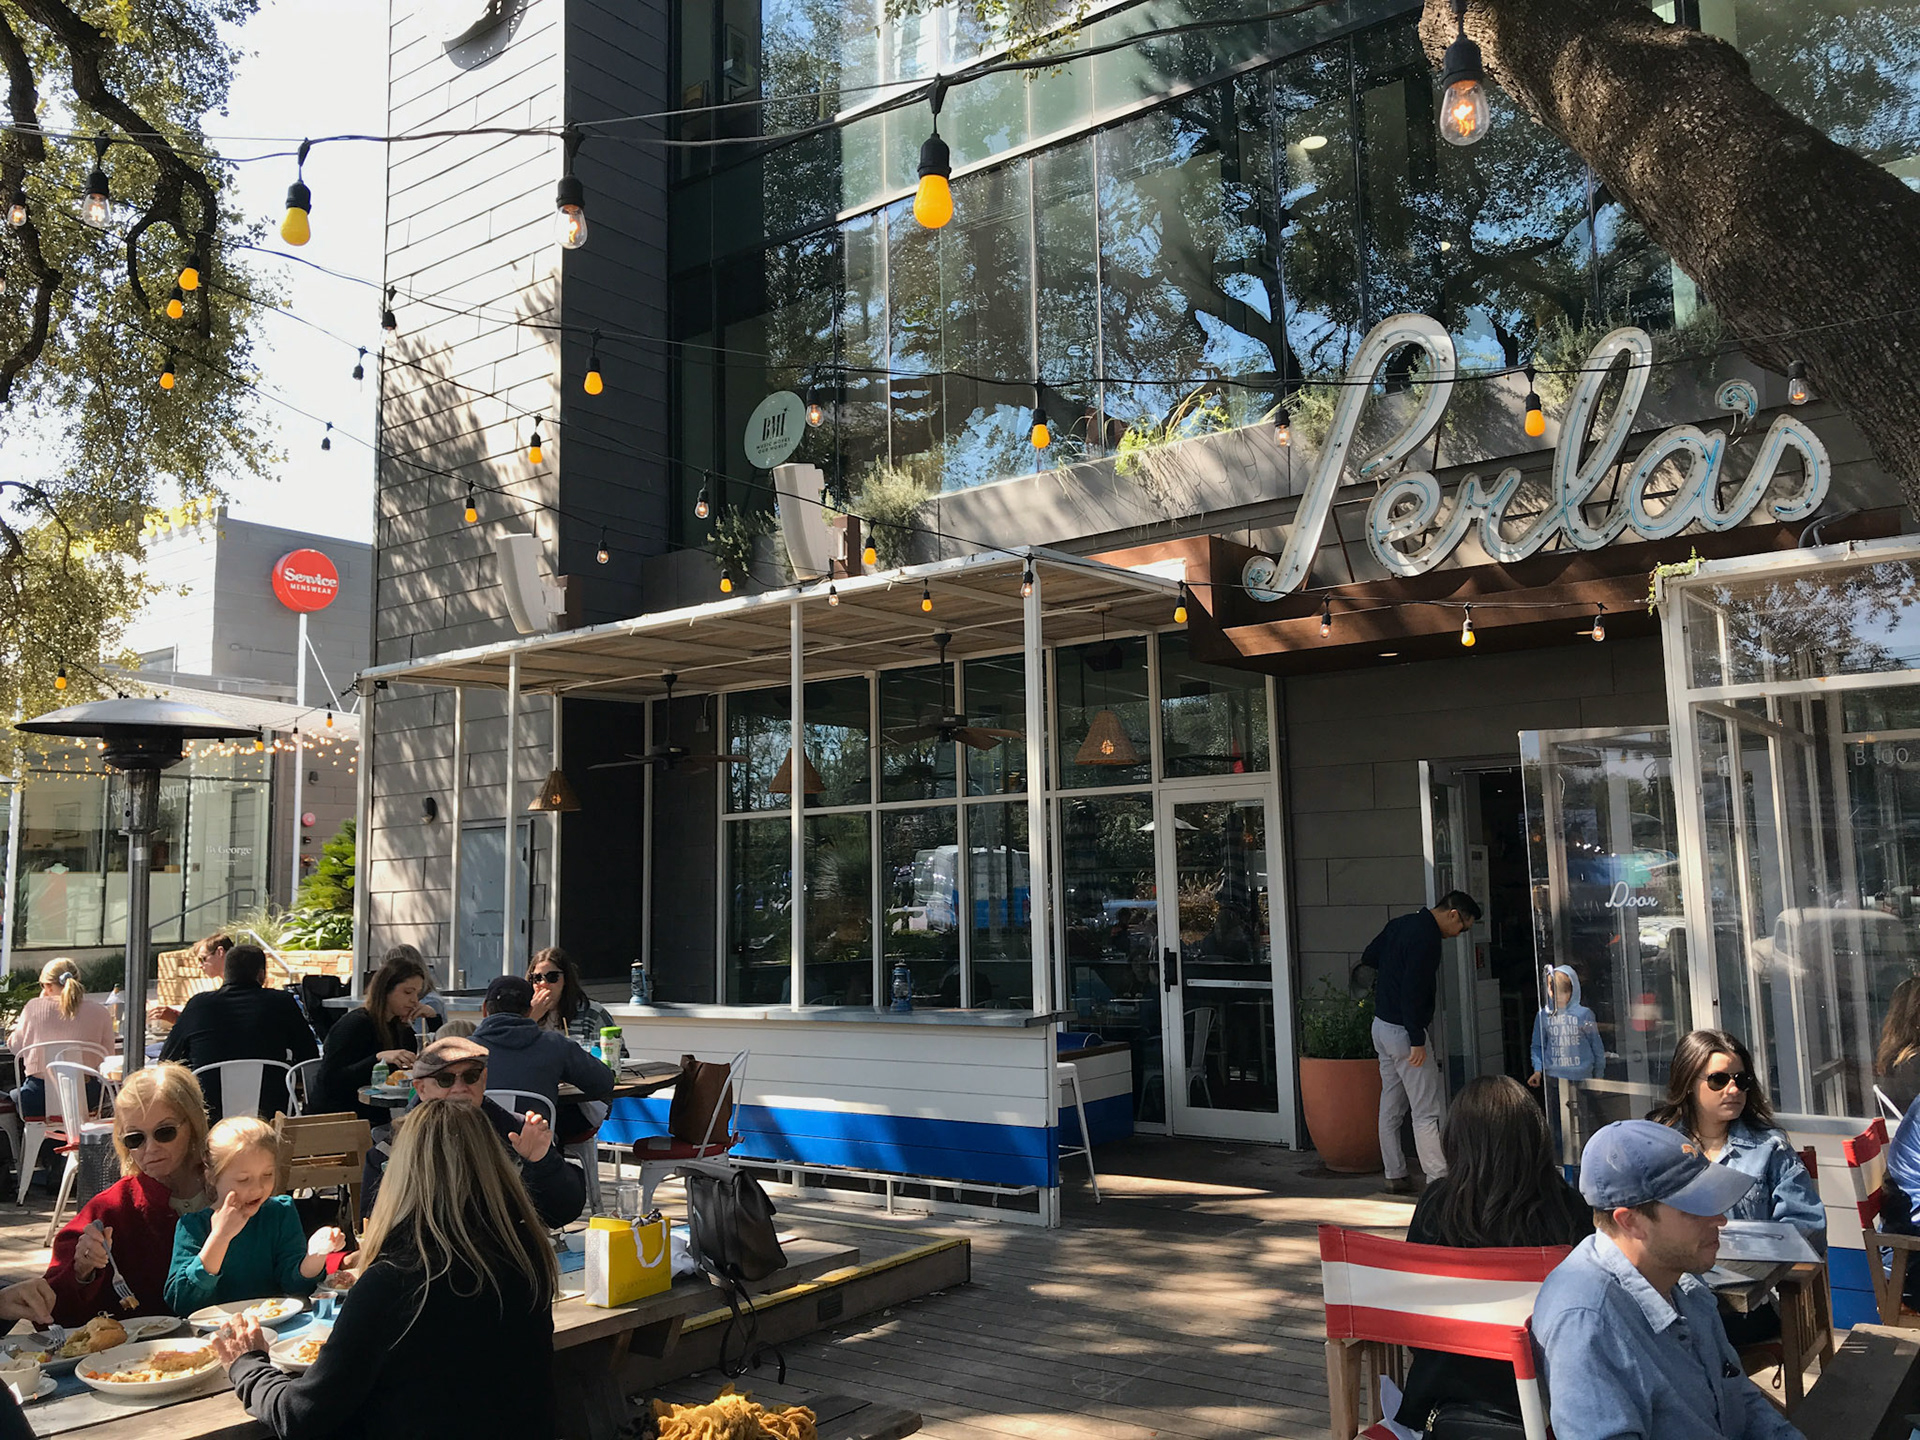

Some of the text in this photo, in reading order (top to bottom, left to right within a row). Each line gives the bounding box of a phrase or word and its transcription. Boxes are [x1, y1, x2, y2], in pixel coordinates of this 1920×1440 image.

[762, 411, 786, 441] BMI
[756, 441, 772, 450] MUSIC
[757, 442, 788, 455] OUR WORLD
[1241, 312, 1832, 603] Perla's
[283, 567, 338, 588] Service
[290, 583, 332, 595] MENSWEAR
[1854, 747, 1909, 766] B 100
[217, 845, 252, 857] George
[1604, 880, 1659, 909] Door
[1546, 1014, 1578, 1025] TIME TO
[1562, 1025, 1579, 1036] AND
[1550, 1035, 1581, 1046] CHANGE
[1551, 1046, 1565, 1057] THE
[1551, 1056, 1581, 1067] WORLD
